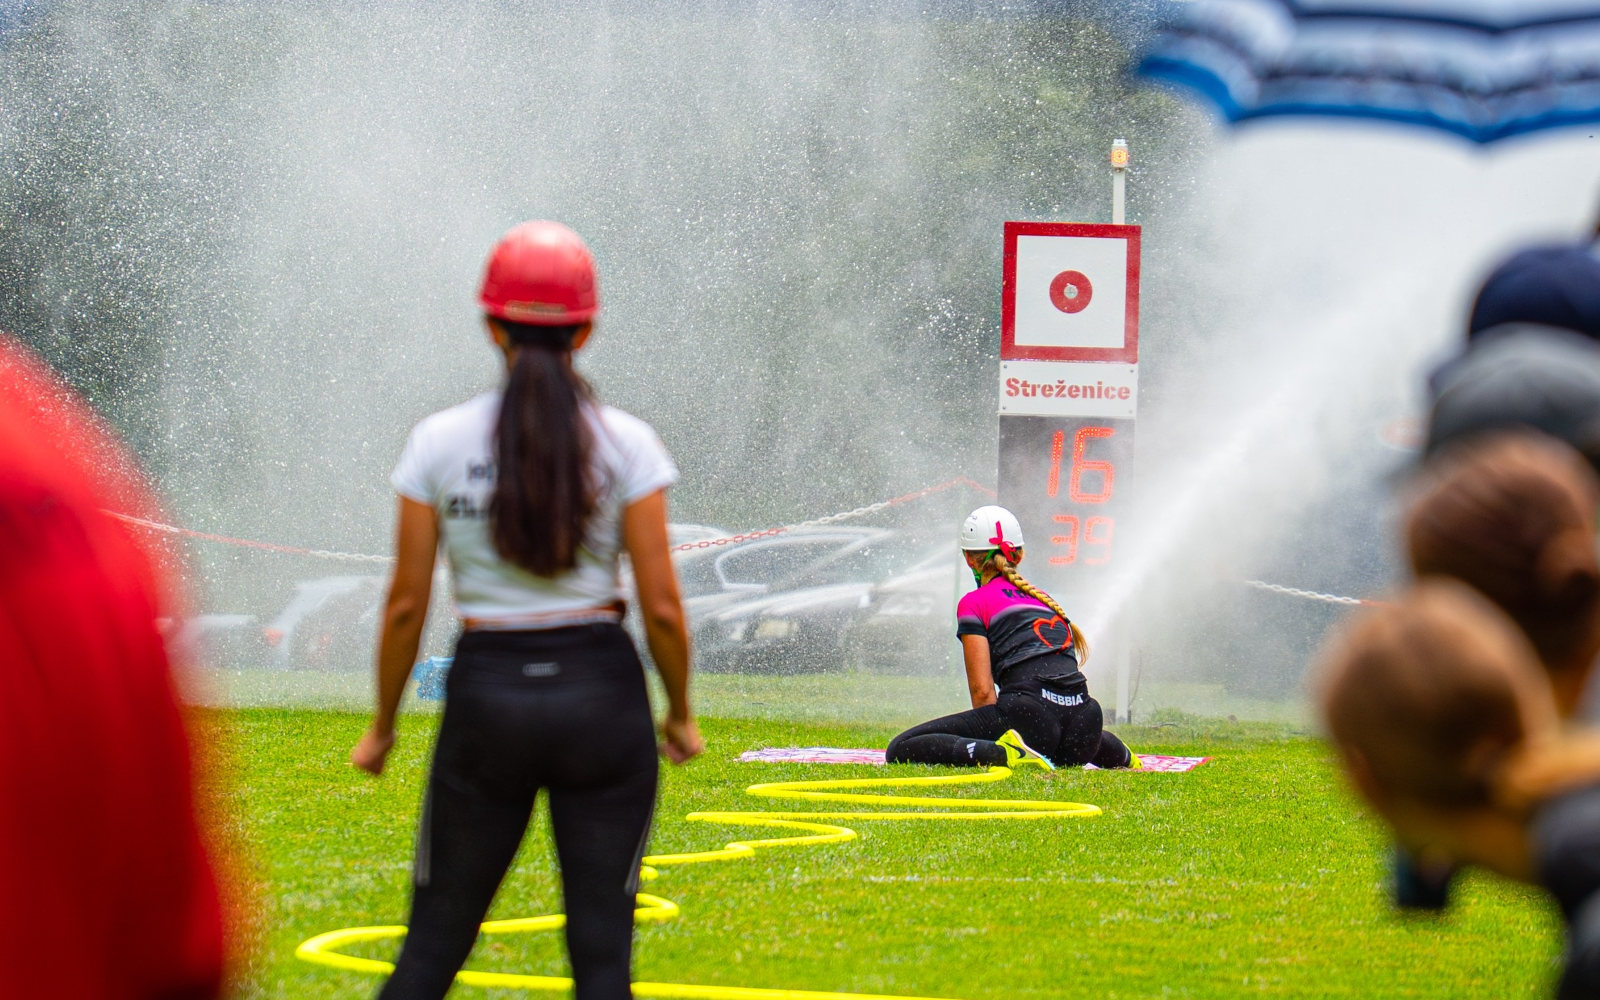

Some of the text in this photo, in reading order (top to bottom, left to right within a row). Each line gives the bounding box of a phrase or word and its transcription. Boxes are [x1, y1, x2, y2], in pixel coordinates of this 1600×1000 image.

[1005, 377, 1131, 400] Streženice
[1047, 426, 1116, 504] 16
[1047, 513, 1116, 567] 39
[1041, 687, 1084, 707] NEBBIA
